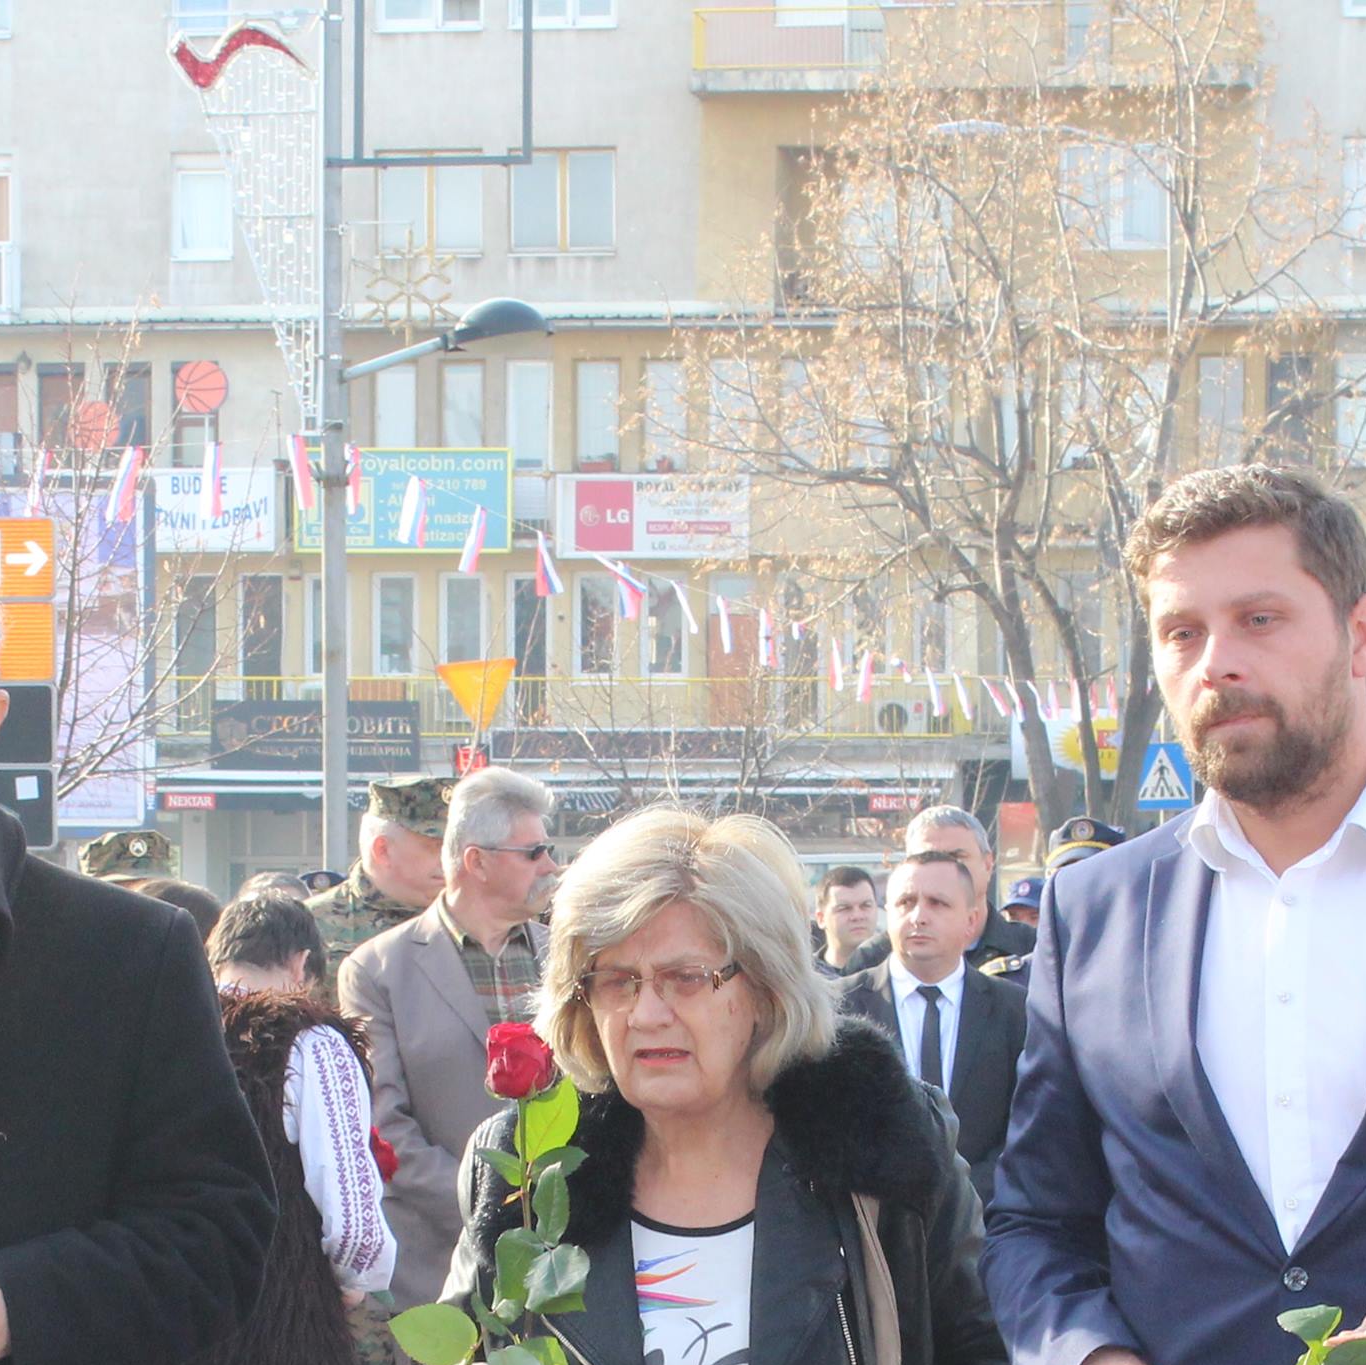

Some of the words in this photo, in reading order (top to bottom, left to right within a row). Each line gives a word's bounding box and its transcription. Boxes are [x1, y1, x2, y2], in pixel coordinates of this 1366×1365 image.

[171, 476, 228, 495] BUDE
[606, 508, 630, 523] LG
[251, 714, 412, 735] СТОЈАОВИЋ
[168, 794, 213, 807] NEKTAR
